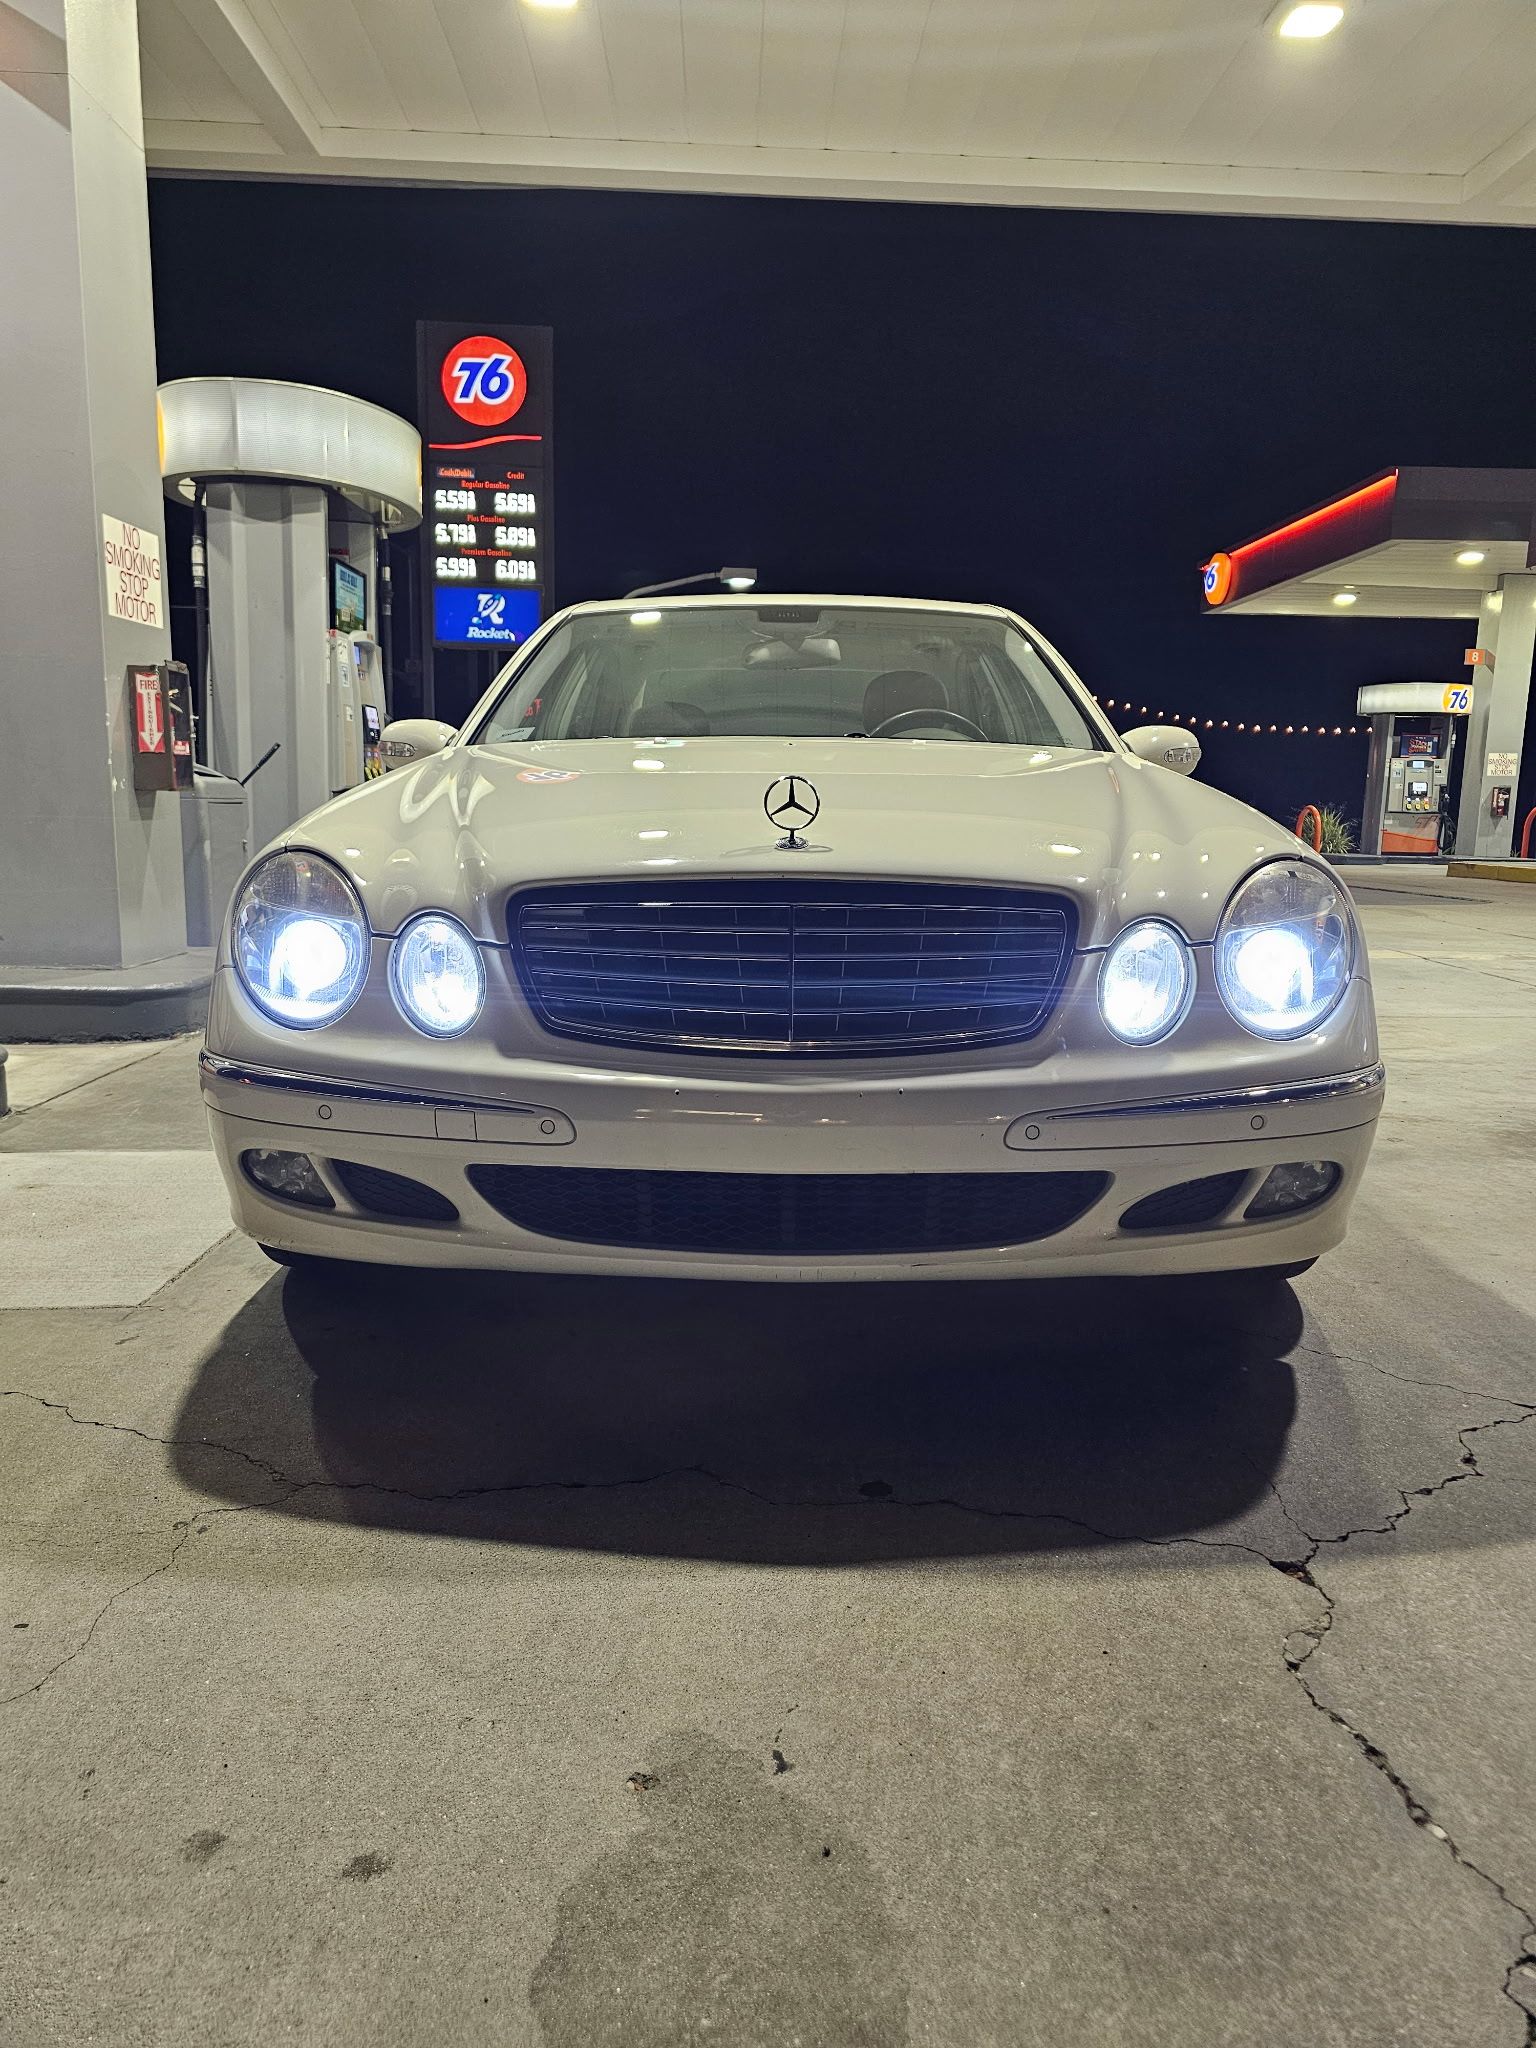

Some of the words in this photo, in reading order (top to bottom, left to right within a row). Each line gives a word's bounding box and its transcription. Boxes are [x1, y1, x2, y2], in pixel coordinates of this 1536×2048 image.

[451, 353, 515, 405] 76
[507, 472, 525, 480] Credit
[461, 480, 484, 489] Regular
[485, 481, 511, 490] Gasoline
[467, 514, 480, 522] Plus
[481, 515, 506, 523] Gasoline
[122, 523, 141, 550] NO
[461, 548, 487, 556] Premium
[487, 549, 512, 557] Gasoline
[105, 541, 161, 581] SMOKING
[120, 570, 149, 598] STOP
[115, 592, 157, 625] MOTOR
[467, 626, 510, 639] Rocket
[1472, 652, 1479, 662] 8
[140, 680, 158, 690] FIRE
[1450, 689, 1468, 710] 76
